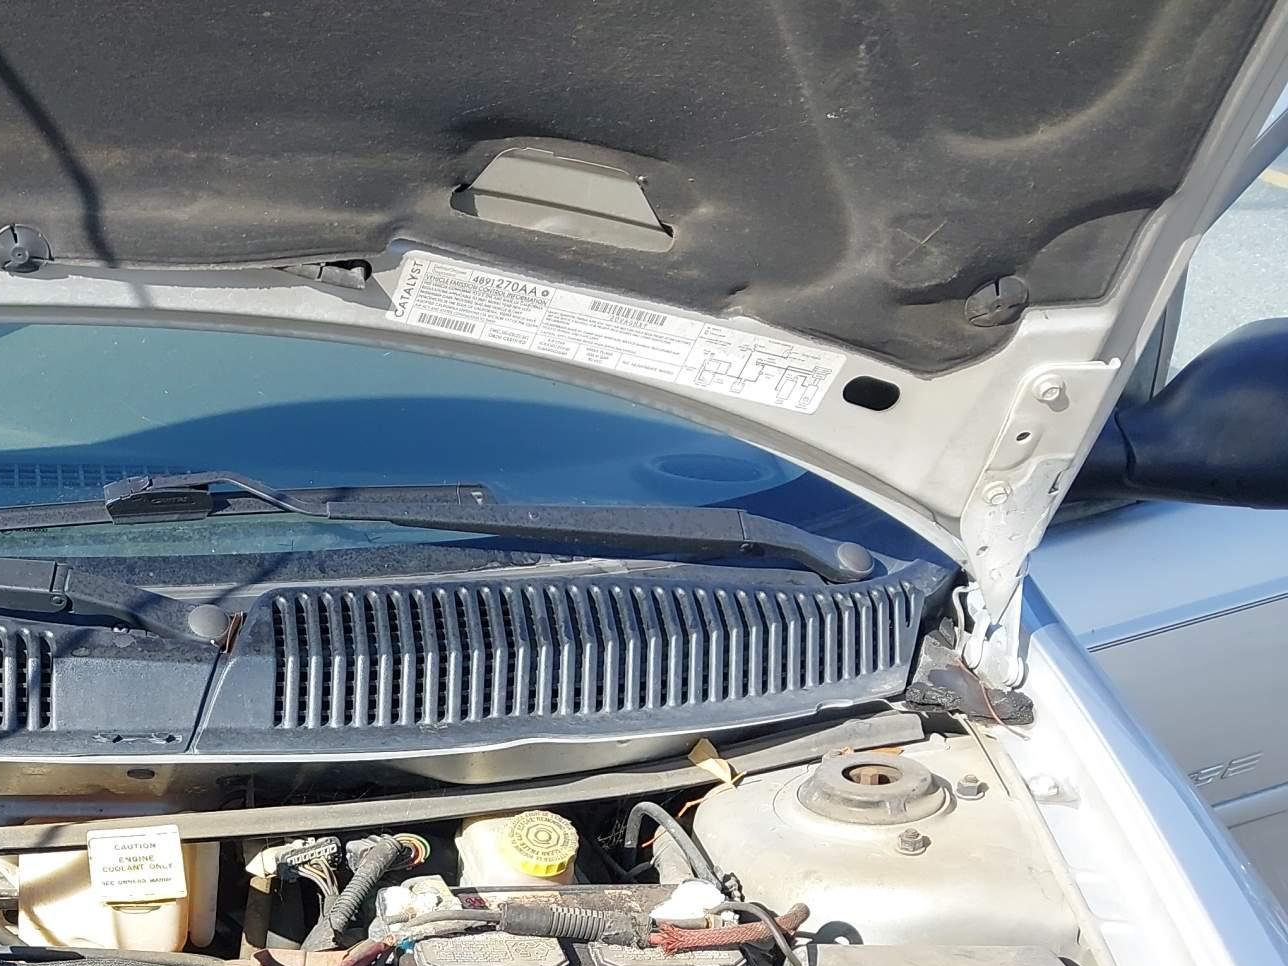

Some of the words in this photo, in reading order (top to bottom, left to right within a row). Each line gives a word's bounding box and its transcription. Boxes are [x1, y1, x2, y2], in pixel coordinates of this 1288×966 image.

[395, 261, 423, 317] CATALYST
[426, 274, 449, 286] VEHICLE
[449, 279, 477, 291] EMISSION
[478, 285, 508, 297] CONTROL
[507, 290, 547, 306] INFORMATION
[472, 275, 538, 297] 4891270AA
[114, 842, 157, 851] CAUTION
[118, 854, 154, 863] ENGINE
[102, 863, 144, 873] COOLANT
[149, 862, 173, 870] ONLY
